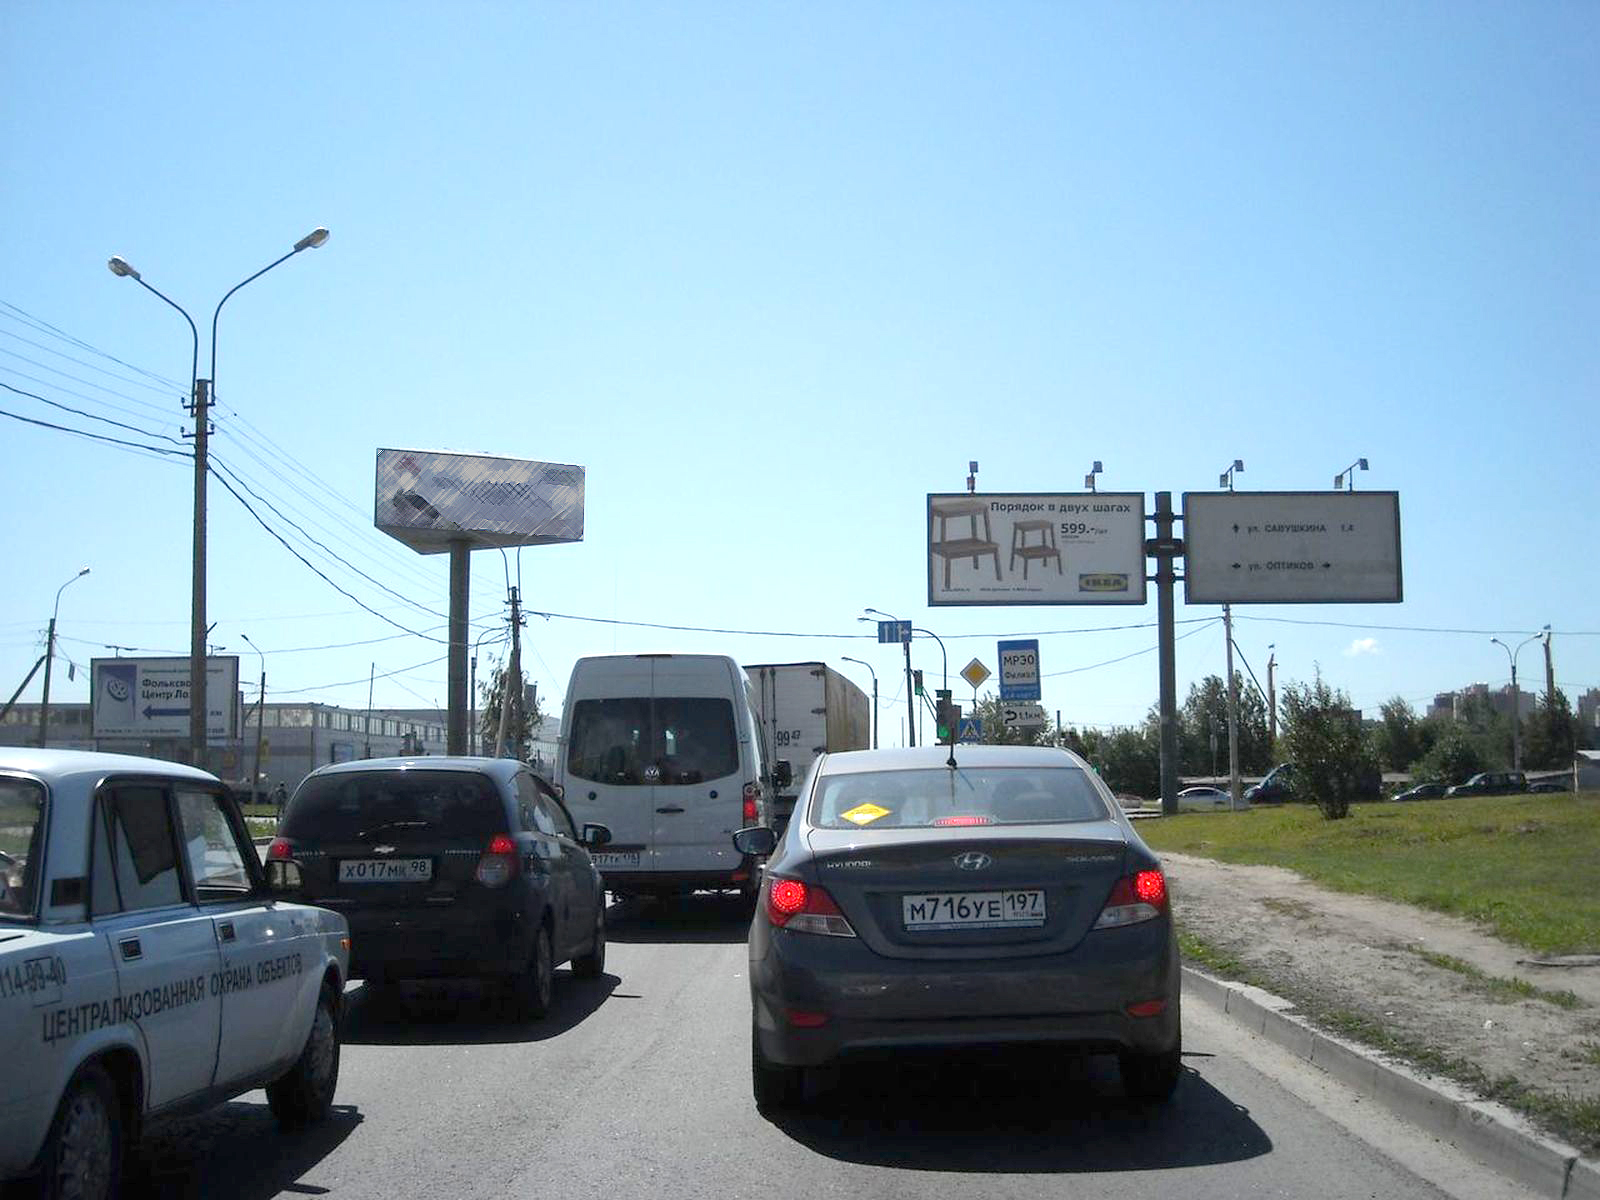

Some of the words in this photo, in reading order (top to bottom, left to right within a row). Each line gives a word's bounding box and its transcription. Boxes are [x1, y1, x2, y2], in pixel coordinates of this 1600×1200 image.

[991, 501, 1045, 513] Порядок
[1047, 503, 1055, 511] в
[1060, 503, 1089, 513] двух
[1093, 503, 1130, 513] шагах
[1265, 524, 1327, 533] САВУШКИНА
[1266, 561, 1314, 570] ОПТИКОВ
[142, 690, 172, 700] Центр
[411, 861, 426, 874] 98
[910, 897, 1001, 921] М716УЕ
[1006, 893, 1039, 911] 197
[43, 976, 205, 1046] ЦЕНТРАЛИЗОВАННАЯ
[210, 962, 252, 997] ОХРАНА
[256, 953, 302, 984] ОБЪЕКТОВ
